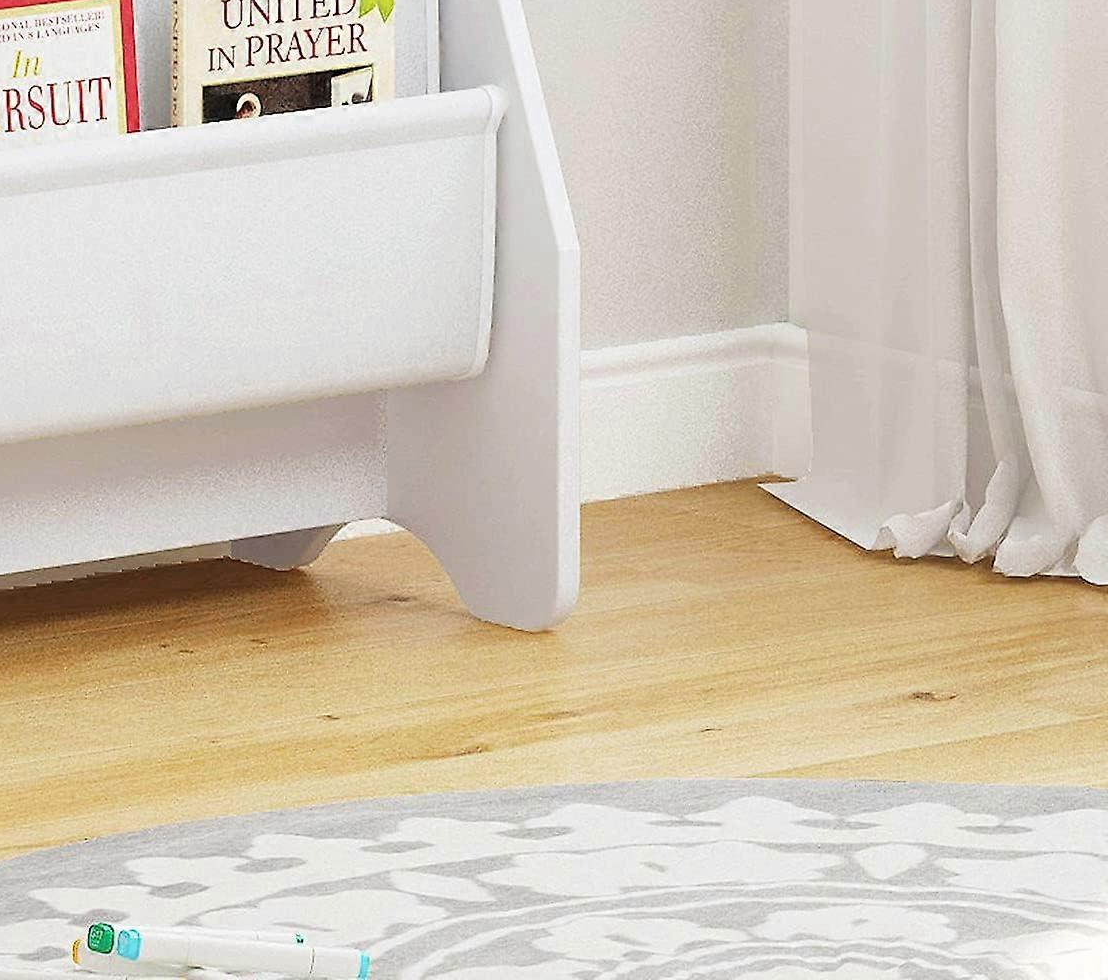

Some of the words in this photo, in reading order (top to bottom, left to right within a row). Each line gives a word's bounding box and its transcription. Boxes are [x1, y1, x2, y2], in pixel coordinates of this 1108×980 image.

[36, 23, 101, 39] LANGUAGES
[208, 46, 236, 71] IN
[245, 23, 368, 67] PRAYER
[12, 50, 40, 79] In
